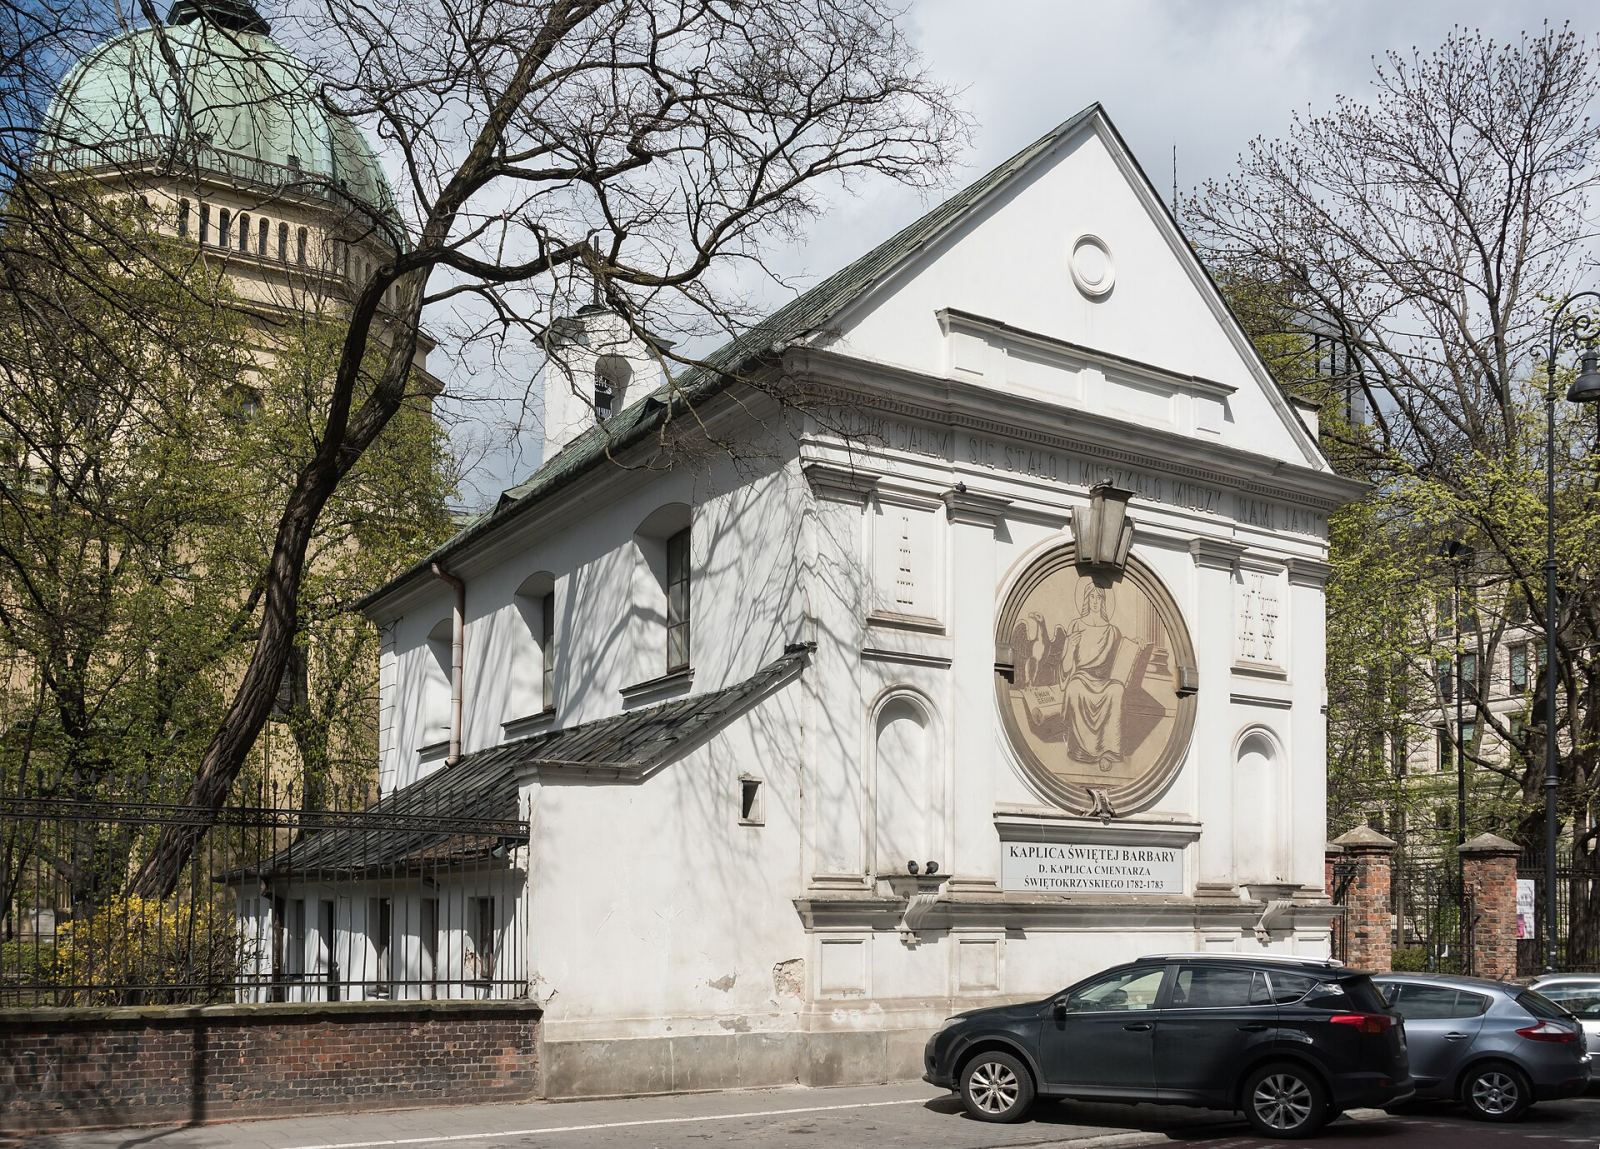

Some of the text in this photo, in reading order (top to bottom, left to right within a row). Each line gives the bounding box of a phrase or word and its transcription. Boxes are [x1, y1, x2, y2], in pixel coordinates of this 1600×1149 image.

[1236, 494, 1275, 528] NAMI
[1009, 844, 1176, 863] KAPLICA ŚWIĘTEJ BARBARY
[1038, 864, 1151, 876] D. KAPLICA CMENTARZA
[1024, 875, 1164, 890] ŚWIĘTOKRZYSKIEGO 1782-1783
